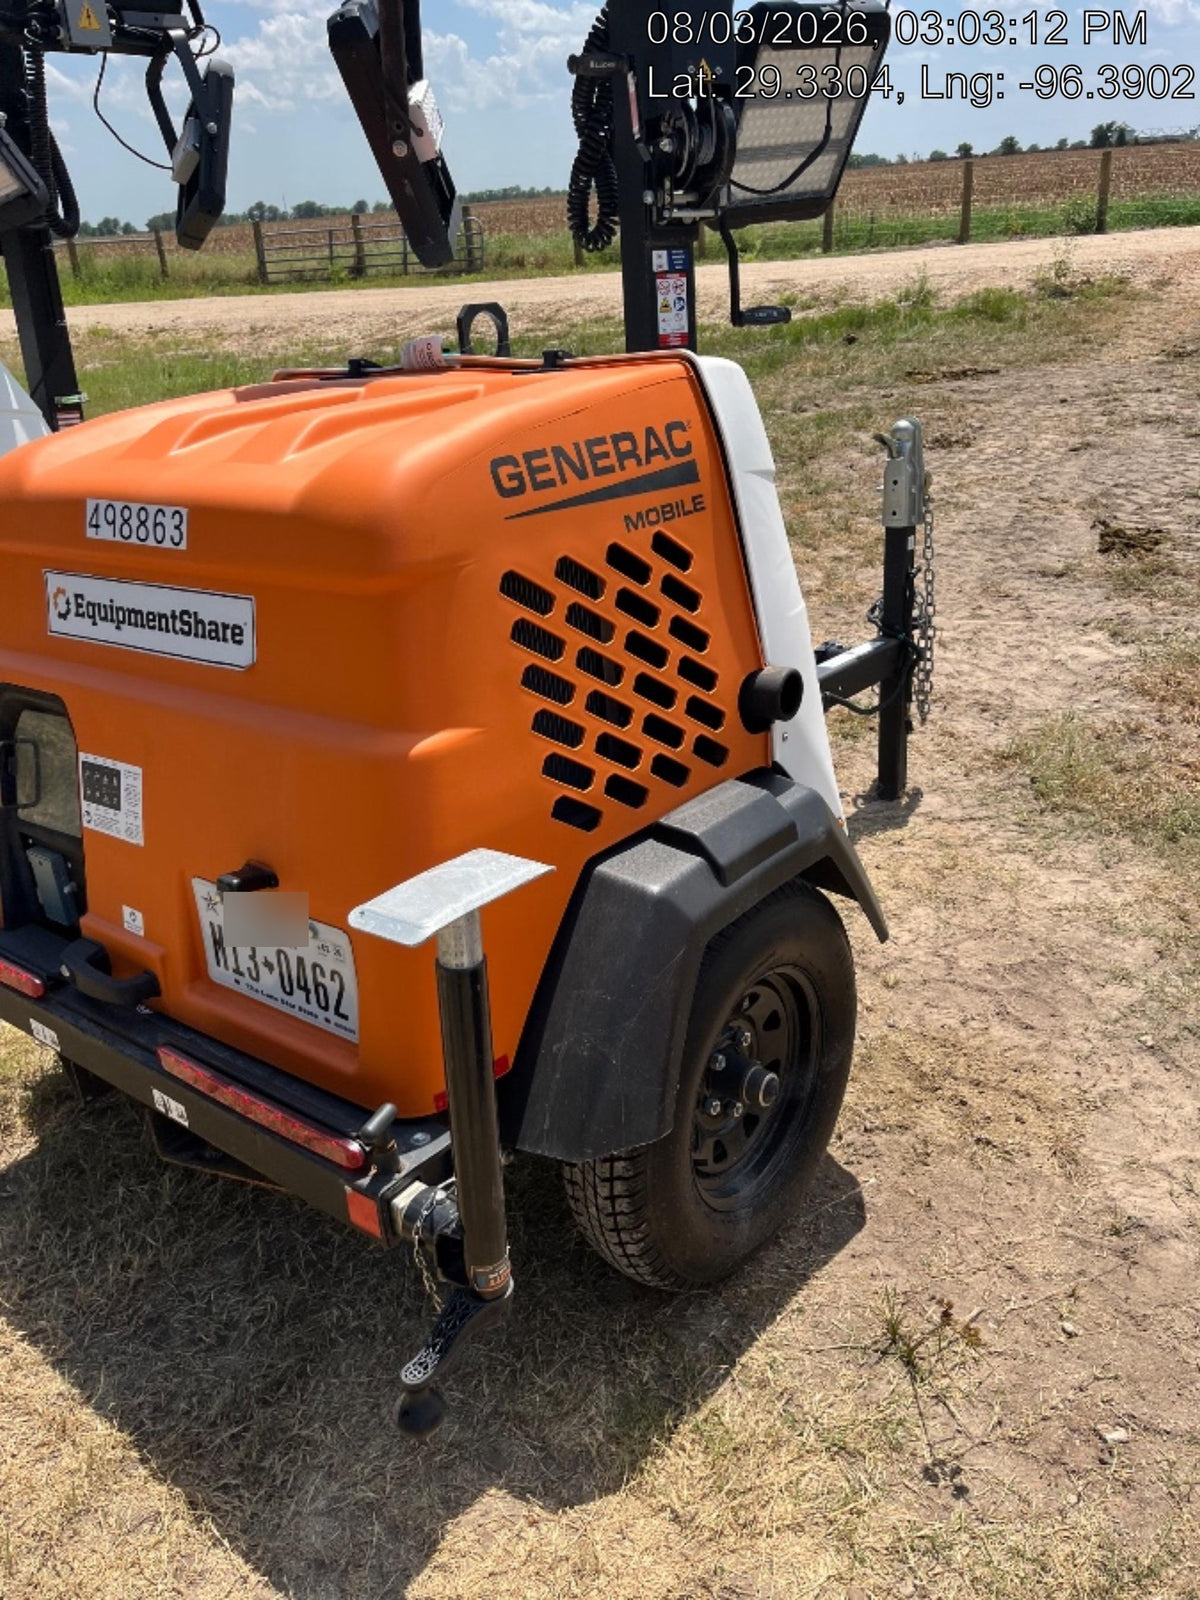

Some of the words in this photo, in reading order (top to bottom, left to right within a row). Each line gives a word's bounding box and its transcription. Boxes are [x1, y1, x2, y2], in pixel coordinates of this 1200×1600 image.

[490, 420, 692, 498] GENERAC
[88, 502, 184, 546] 498863
[623, 494, 706, 533] MOBILE
[73, 593, 244, 645] EquipmentShare
